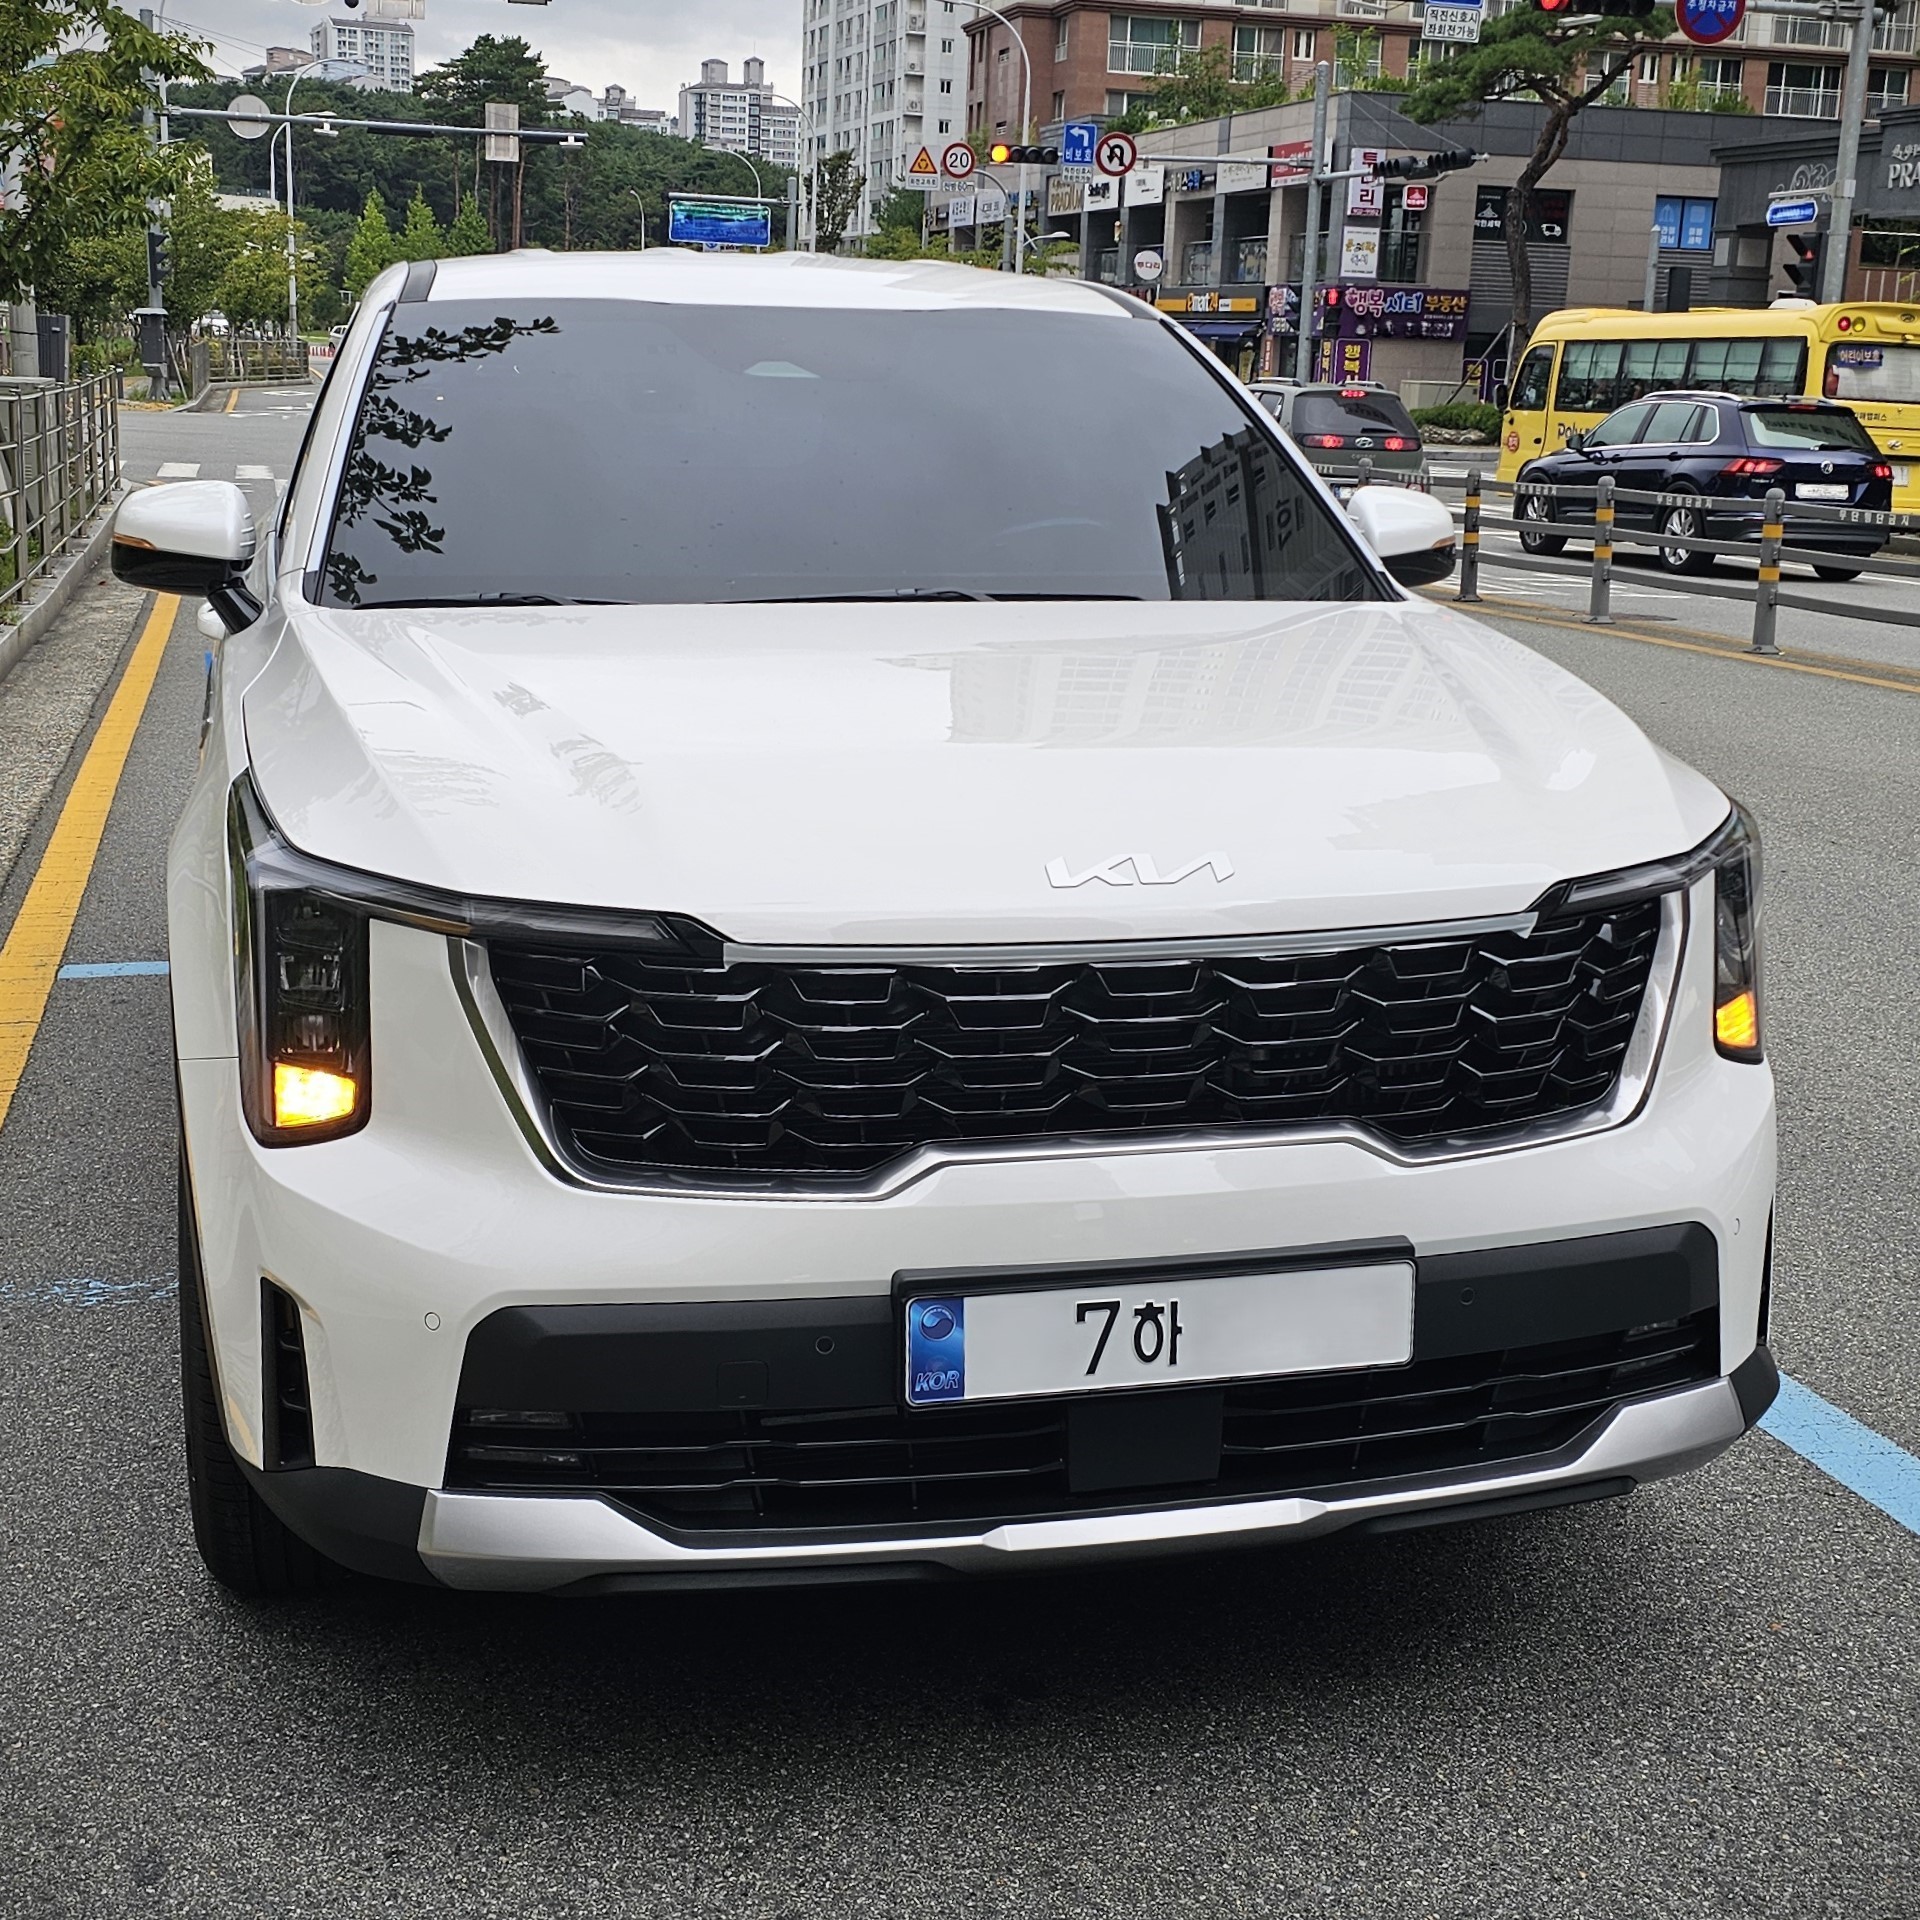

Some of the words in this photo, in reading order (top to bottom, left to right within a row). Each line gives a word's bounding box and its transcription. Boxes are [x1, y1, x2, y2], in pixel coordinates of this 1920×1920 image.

[1430, 10, 1478, 24] 직진신호시
[1428, 23, 1475, 38] 좌회전가능
[949, 152, 969, 168] 20
[1065, 147, 1092, 162] 비보호
[1424, 295, 1467, 313] 부동산
[1656, 494, 1712, 508] 무단횡단금지
[1839, 510, 1909, 526] 무단횡단금지
[1045, 851, 1235, 888] KIA
[1075, 1298, 1183, 1376] 7하
[915, 1370, 960, 1392] KOR
